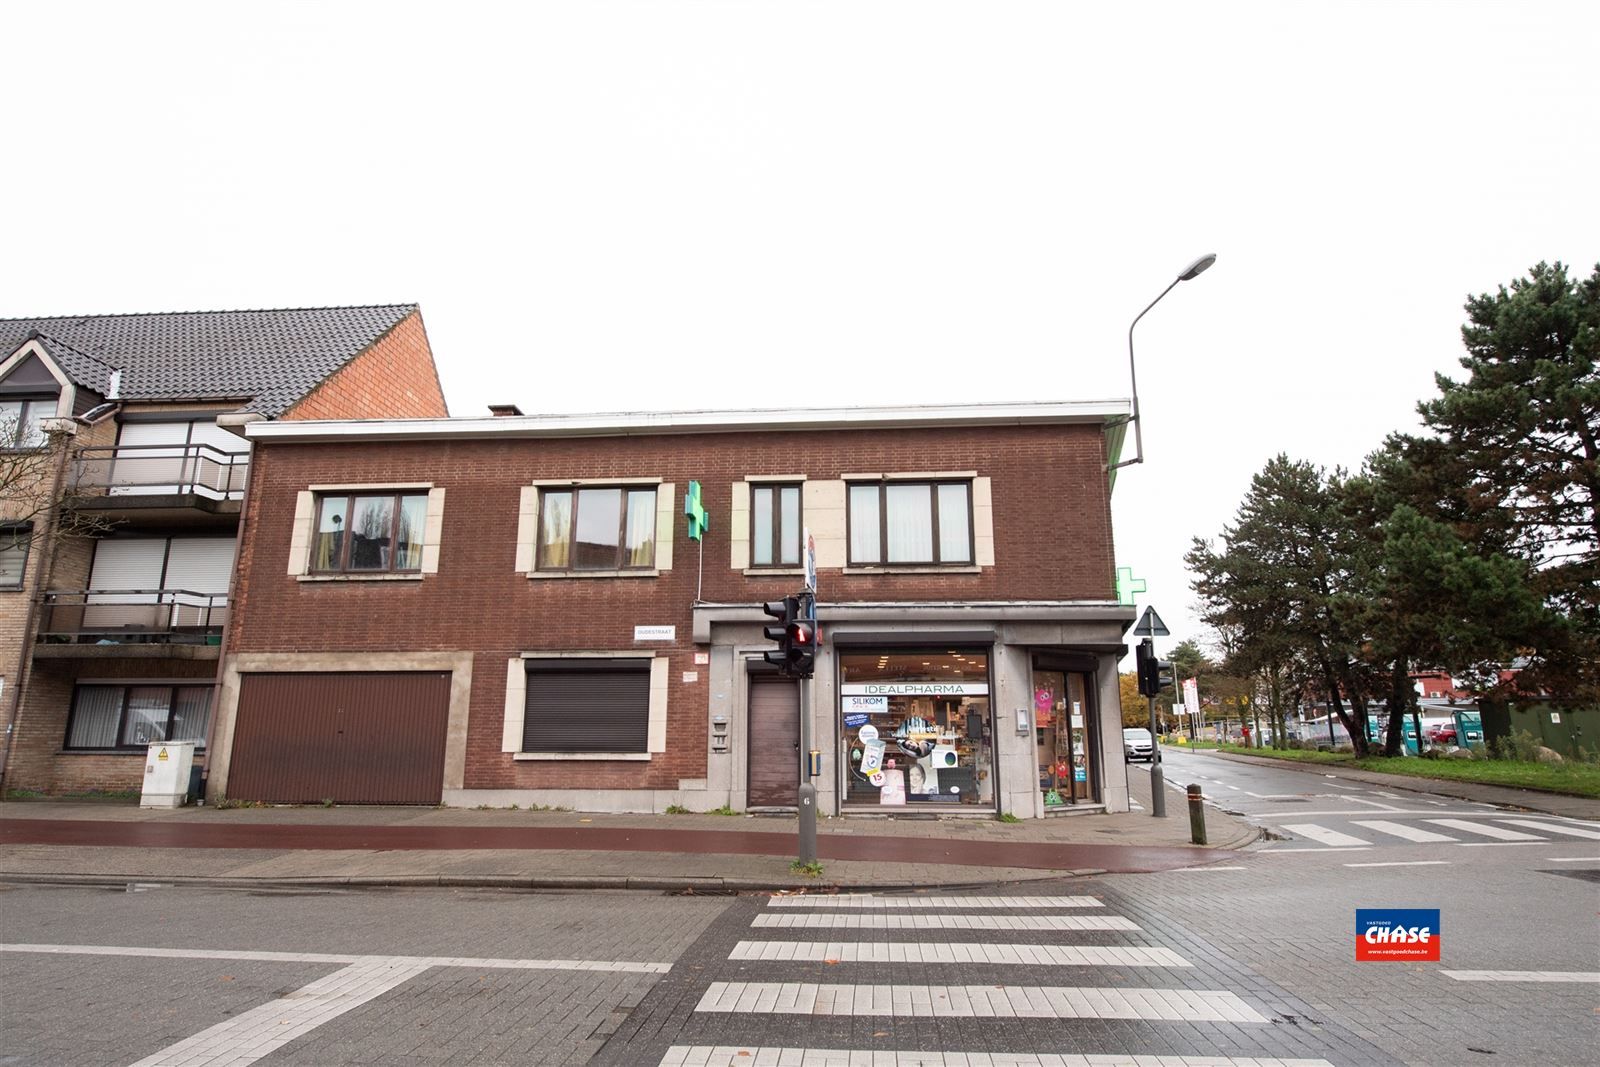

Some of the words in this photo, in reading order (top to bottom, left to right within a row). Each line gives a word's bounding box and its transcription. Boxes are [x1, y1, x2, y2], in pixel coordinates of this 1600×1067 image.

[864, 685, 964, 694] IDEALPHARMA
[852, 697, 883, 705] SILIKOM
[873, 773, 882, 781] 15
[803, 797, 810, 805] 6
